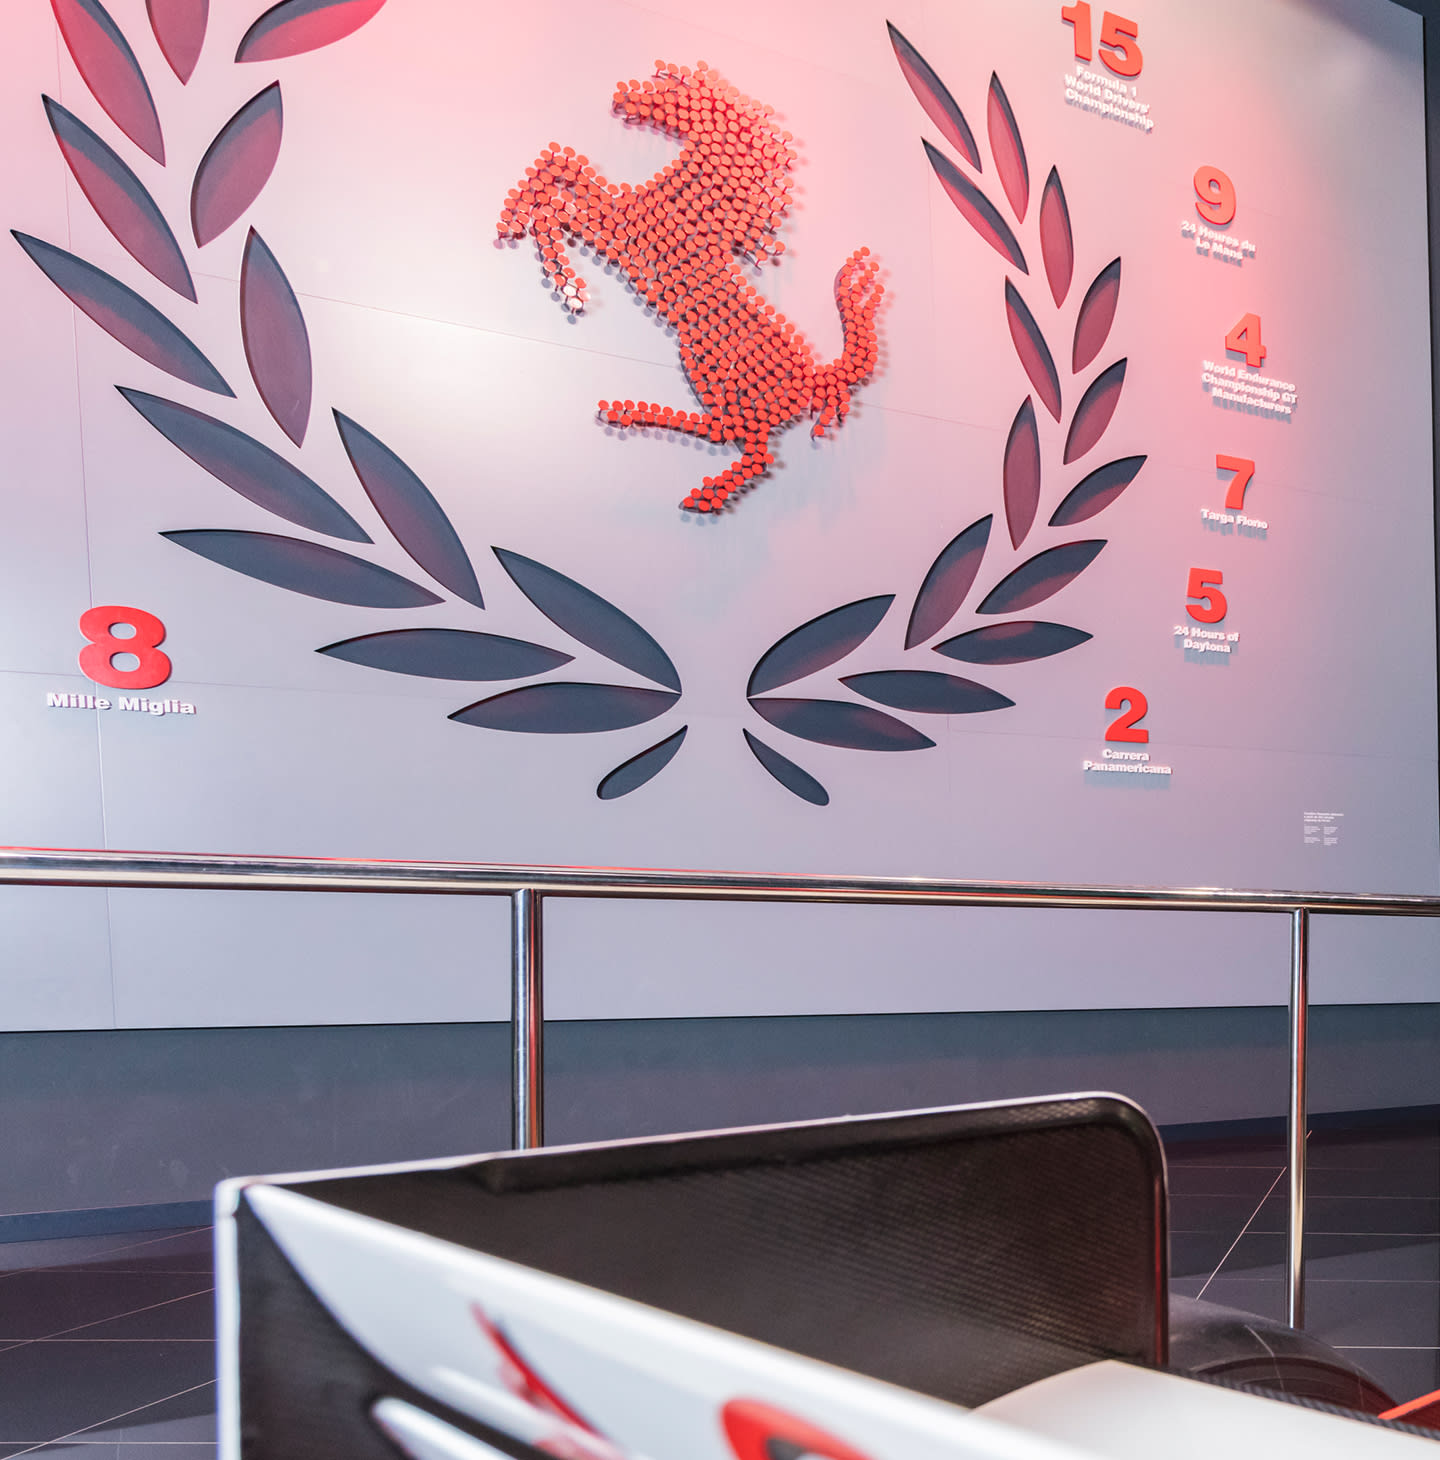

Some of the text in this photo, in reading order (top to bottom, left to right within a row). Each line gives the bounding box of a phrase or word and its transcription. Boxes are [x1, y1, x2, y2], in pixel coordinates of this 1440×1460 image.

[1062, 0, 1143, 77] 15
[1065, 74, 1102, 97] World
[1076, 65, 1137, 97] Formula 1
[1065, 88, 1155, 129] Championship
[1193, 165, 1236, 226] 9
[1181, 220, 1255, 252] 24 Heures du
[1196, 237, 1243, 260] Le Mans
[1225, 312, 1267, 368] 4
[1201, 372, 1298, 404] Championship GT
[1203, 360, 1296, 392] World Endurance
[1212, 387, 1292, 414] Manufacturers
[1216, 453, 1256, 510] 7
[1200, 508, 1234, 525] Targa
[1185, 567, 1228, 624] 5
[78, 605, 172, 690] 8
[1174, 625, 1240, 642] 24 Hours of
[1183, 638, 1232, 653] Daytona
[46, 692, 197, 717] Mille Miglia
[1104, 686, 1149, 744] 2
[1083, 760, 1173, 775] Panamericana
[1102, 749, 1151, 761] Carrera
